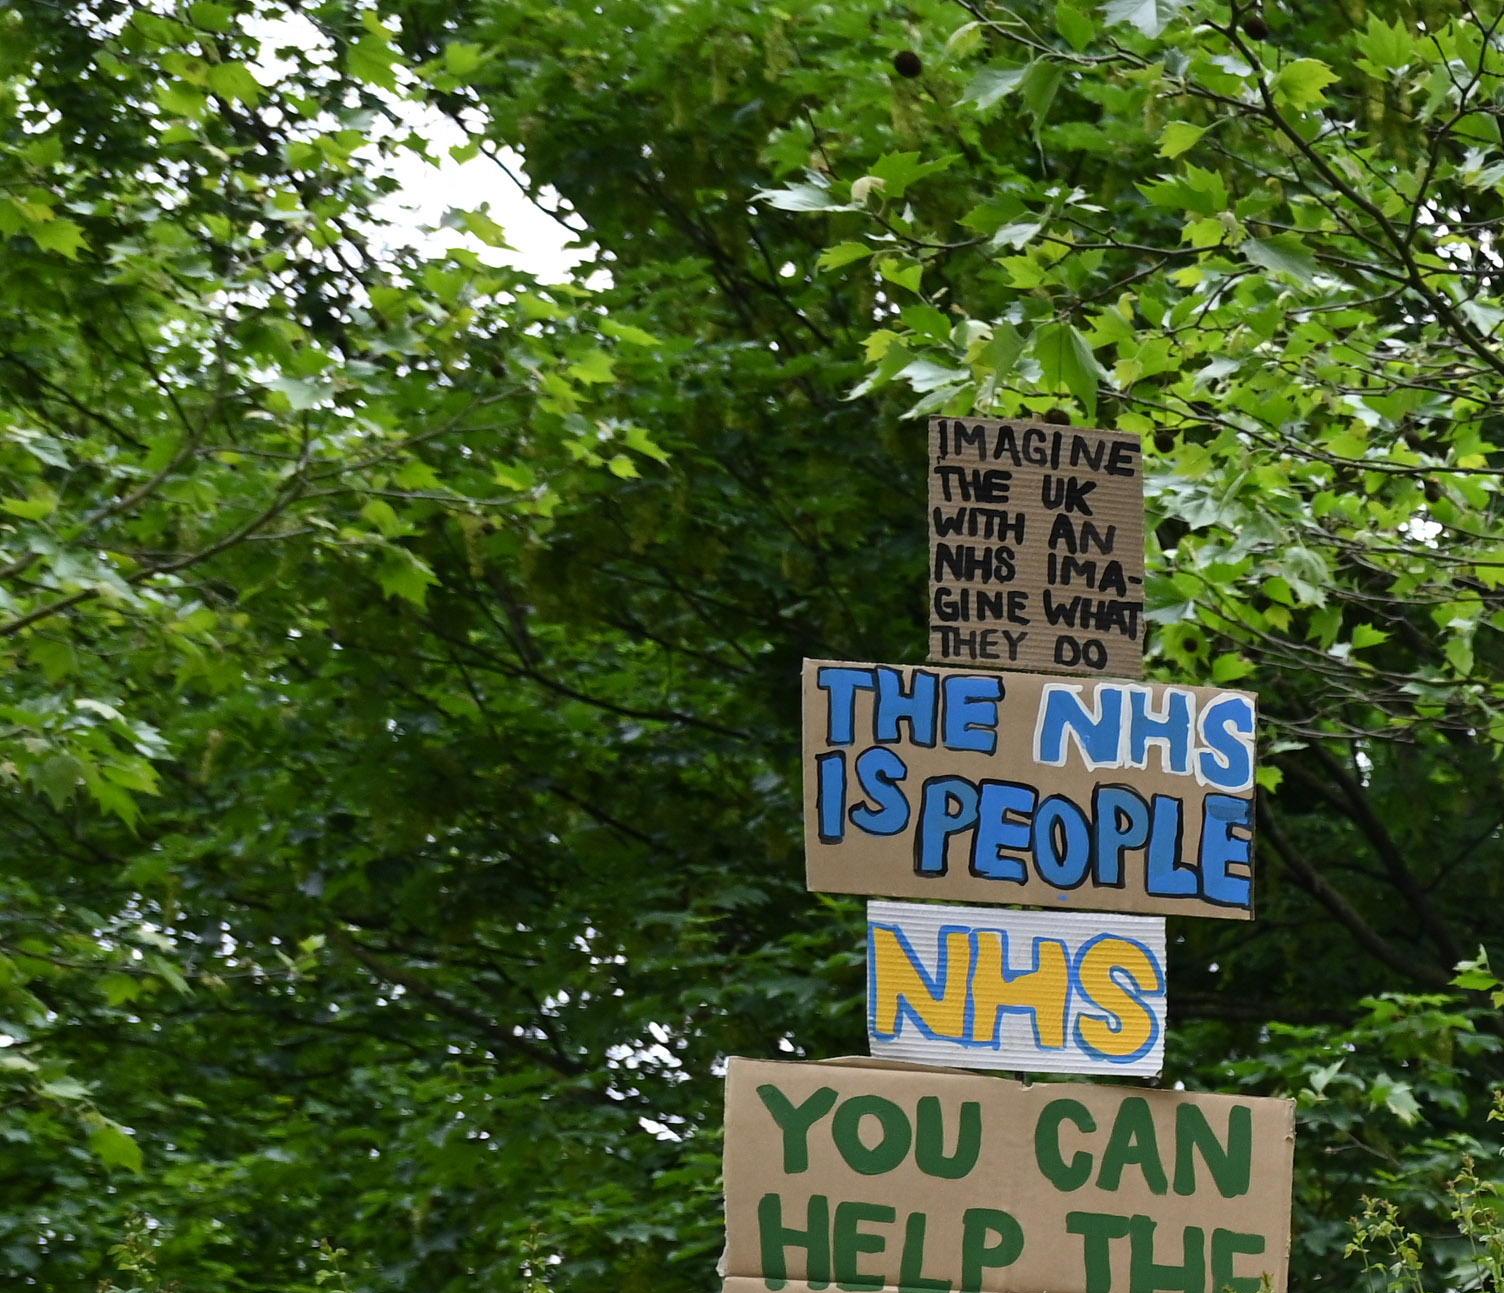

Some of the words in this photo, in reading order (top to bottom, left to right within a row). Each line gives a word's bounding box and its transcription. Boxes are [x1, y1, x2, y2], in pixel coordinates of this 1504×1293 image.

[938, 420, 1141, 477] IMAGINE
[934, 465, 1012, 505] THE
[1042, 475, 1096, 517] UK
[933, 507, 1025, 545] WITH
[1049, 516, 1116, 556] AN
[933, 542, 1015, 583] NHS
[933, 589, 1030, 626] GINE
[1044, 597, 1142, 639] WHAT
[932, 625, 1027, 662] THEY
[1054, 637, 1108, 670] DO
[816, 665, 1004, 755] THE
[1034, 682, 1255, 791] NHS
[816, 746, 910, 844] IS
[915, 775, 1252, 909] PEOPLE
[867, 923, 1166, 1063] NHS
[756, 1084, 982, 1179] YOU
[1034, 1096, 1252, 1198] CAN
